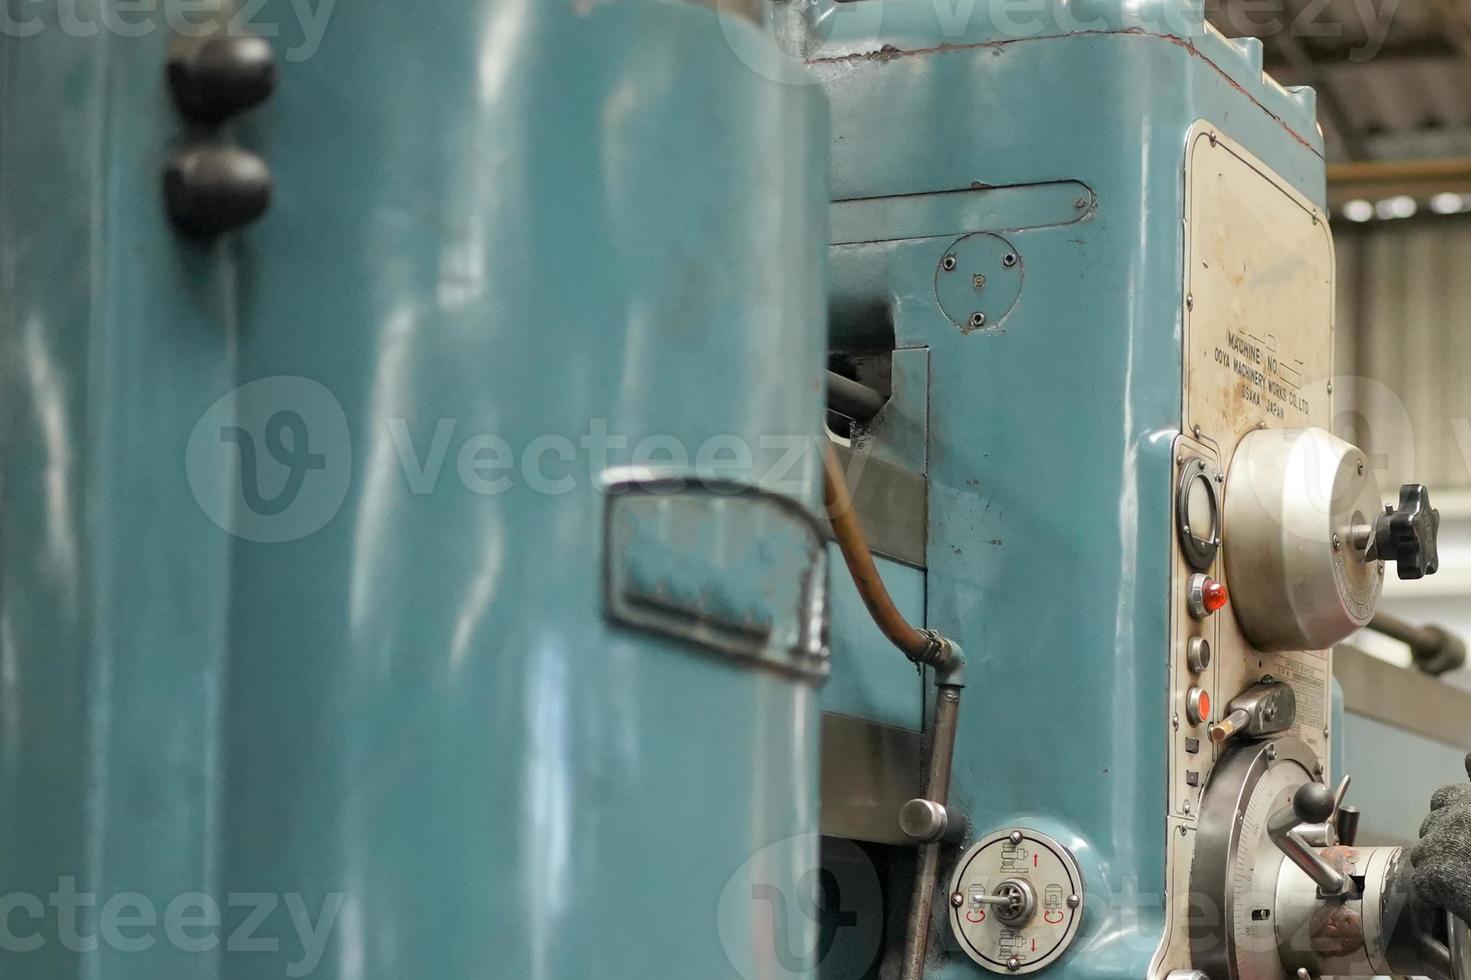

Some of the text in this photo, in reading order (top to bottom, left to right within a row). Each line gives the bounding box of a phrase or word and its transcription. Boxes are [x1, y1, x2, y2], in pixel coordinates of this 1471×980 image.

[1228, 330, 1260, 365] MACHINE
[1214, 347, 1230, 369] OOYA
[1233, 357, 1267, 390] MACHINERY
[1268, 378, 1287, 402] WORKS
[1241, 384, 1285, 420] OSAKA JAPAN
